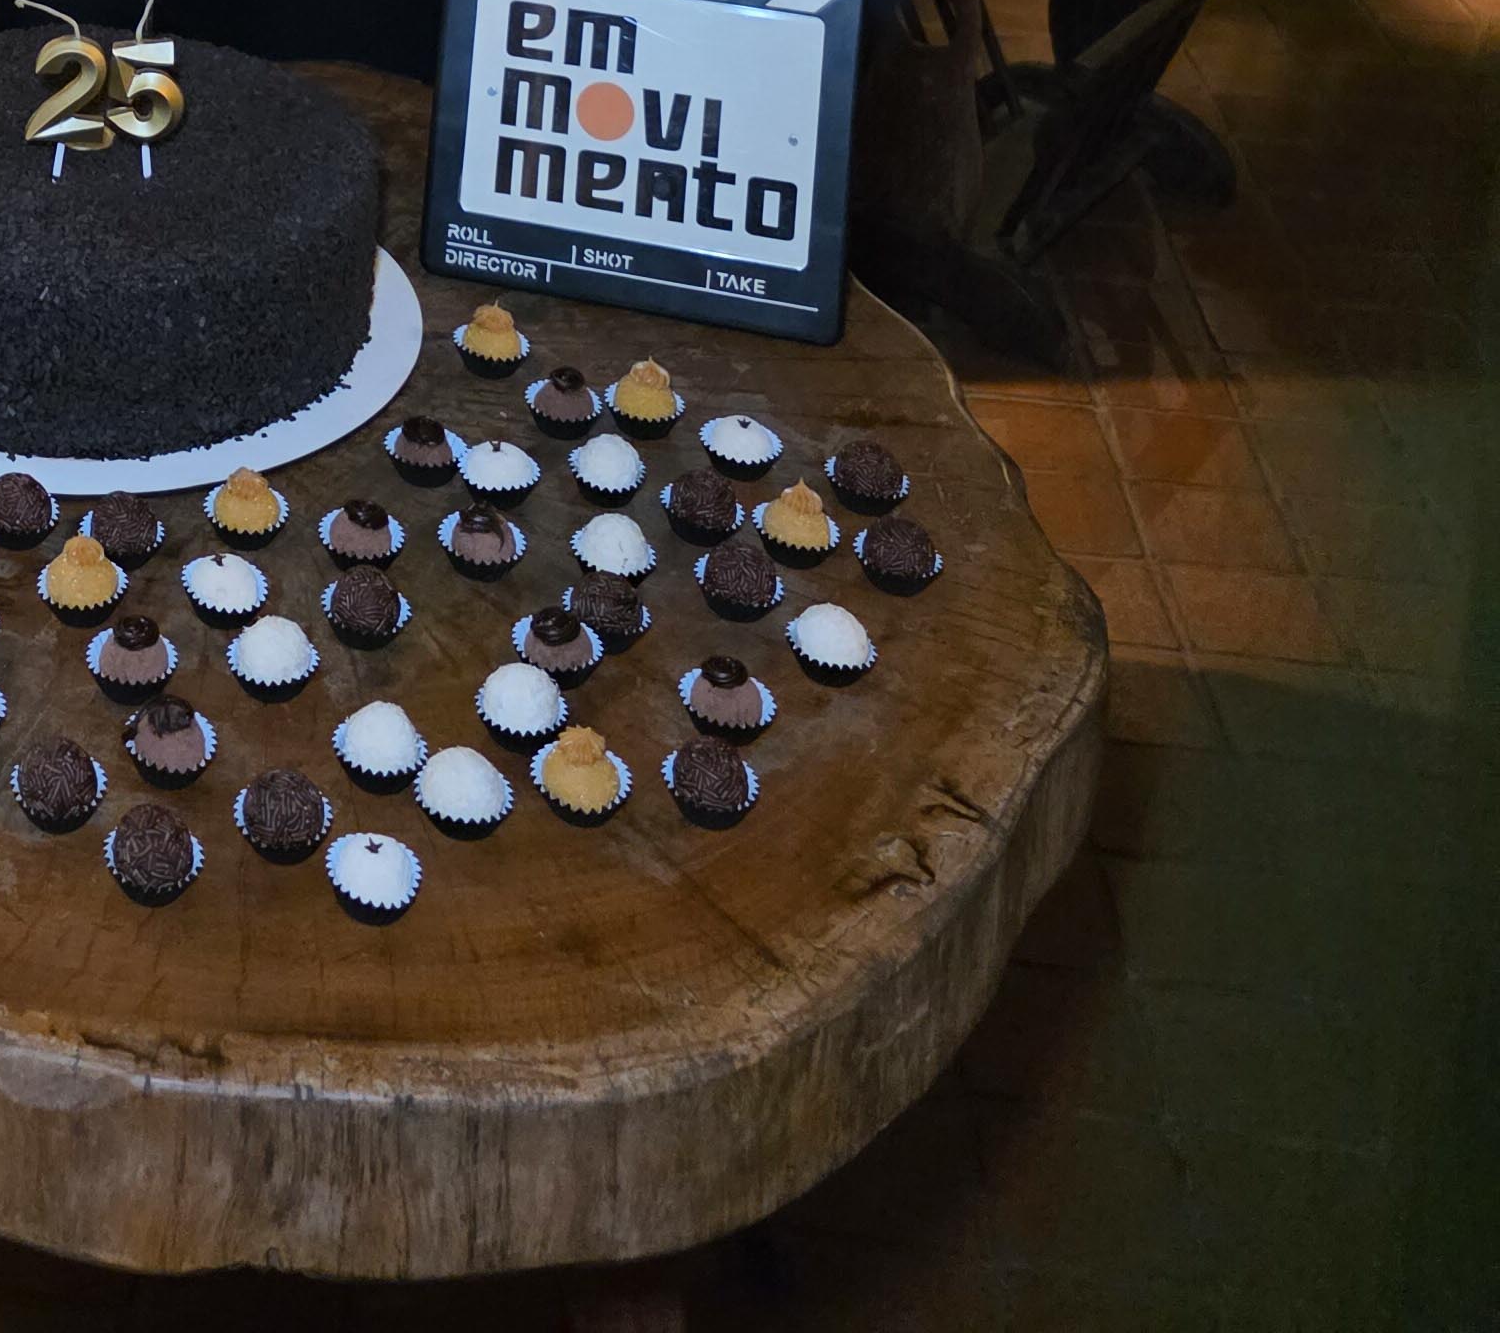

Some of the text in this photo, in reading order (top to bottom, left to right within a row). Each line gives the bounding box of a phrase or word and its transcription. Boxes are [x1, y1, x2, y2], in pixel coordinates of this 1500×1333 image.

[505, 0, 638, 75] em
[25, 35, 185, 152] 25
[447, 223, 493, 247] ROLL
[445, 248, 538, 281] DIRECTOR
[582, 247, 634, 271] SHOT
[715, 270, 767, 296] TAKE
